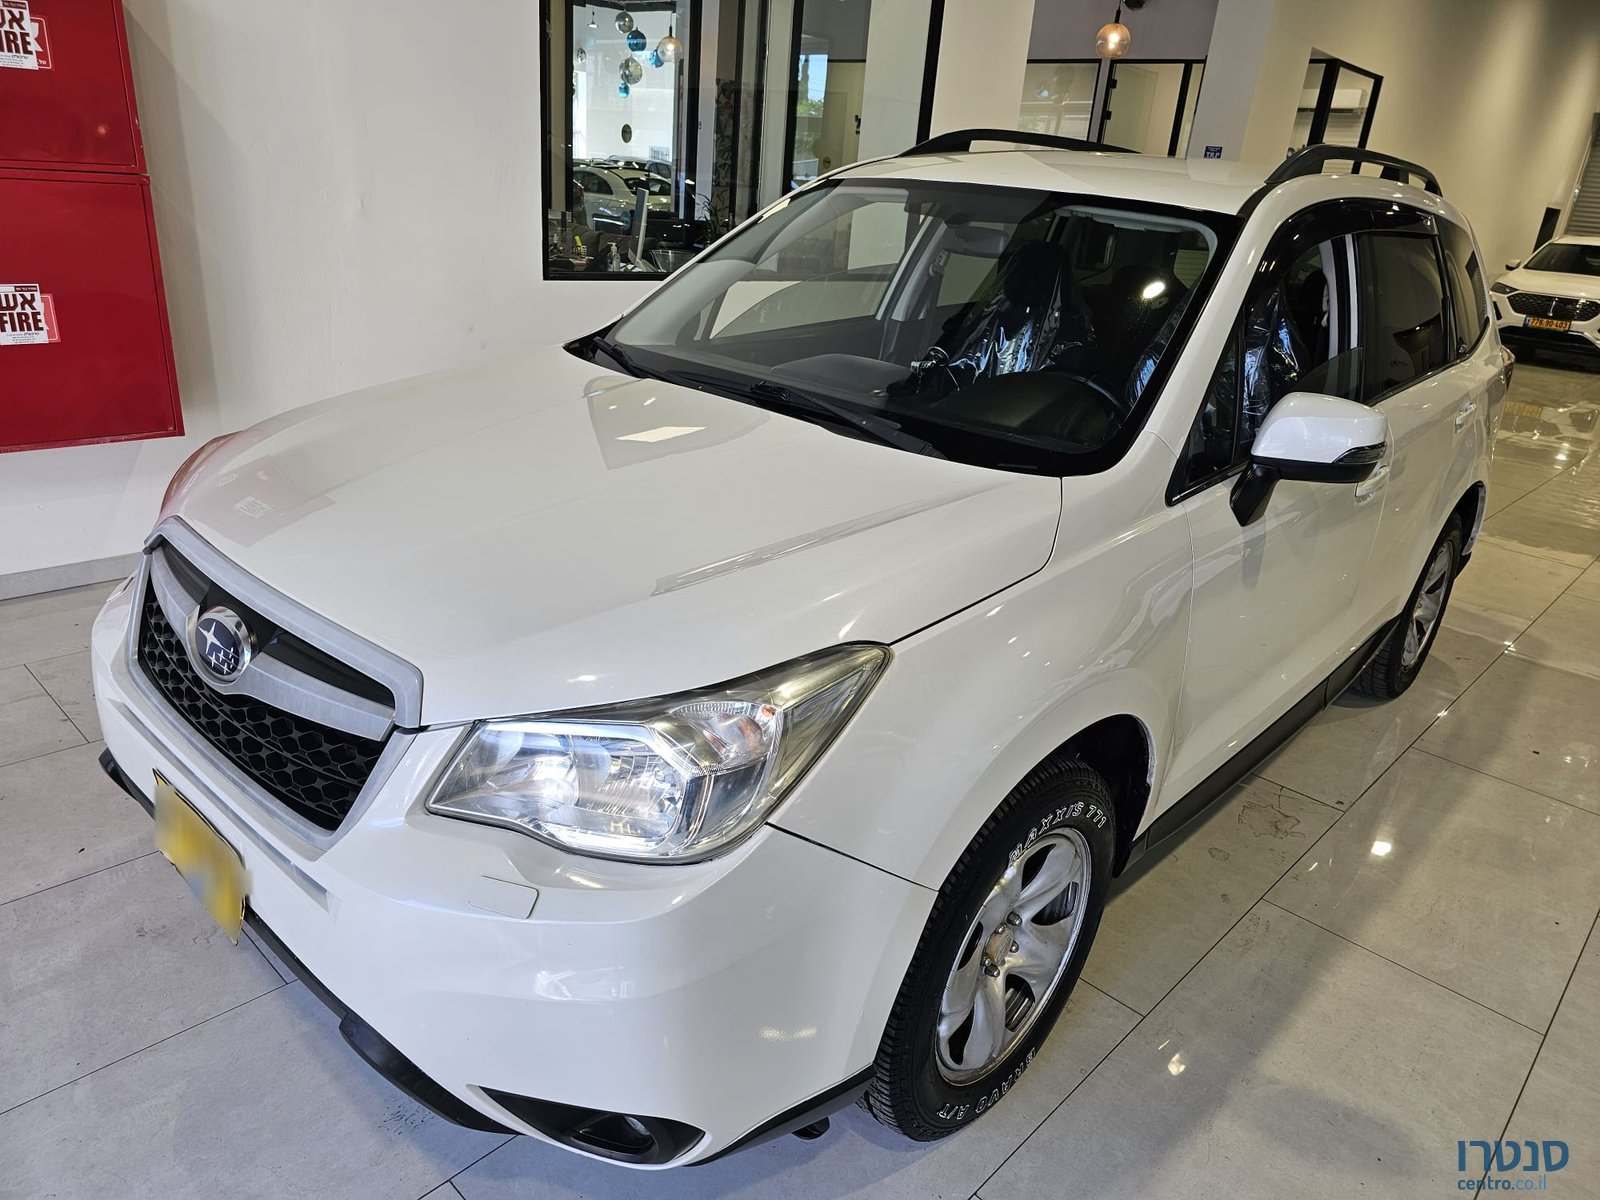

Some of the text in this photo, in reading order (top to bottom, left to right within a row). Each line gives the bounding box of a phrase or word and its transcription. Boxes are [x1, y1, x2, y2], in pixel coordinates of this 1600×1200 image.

[0, 311, 45, 333] FIRE
[1008, 801, 1107, 868] MAXXIS 771
[975, 1046, 1036, 1114] BRAVO
